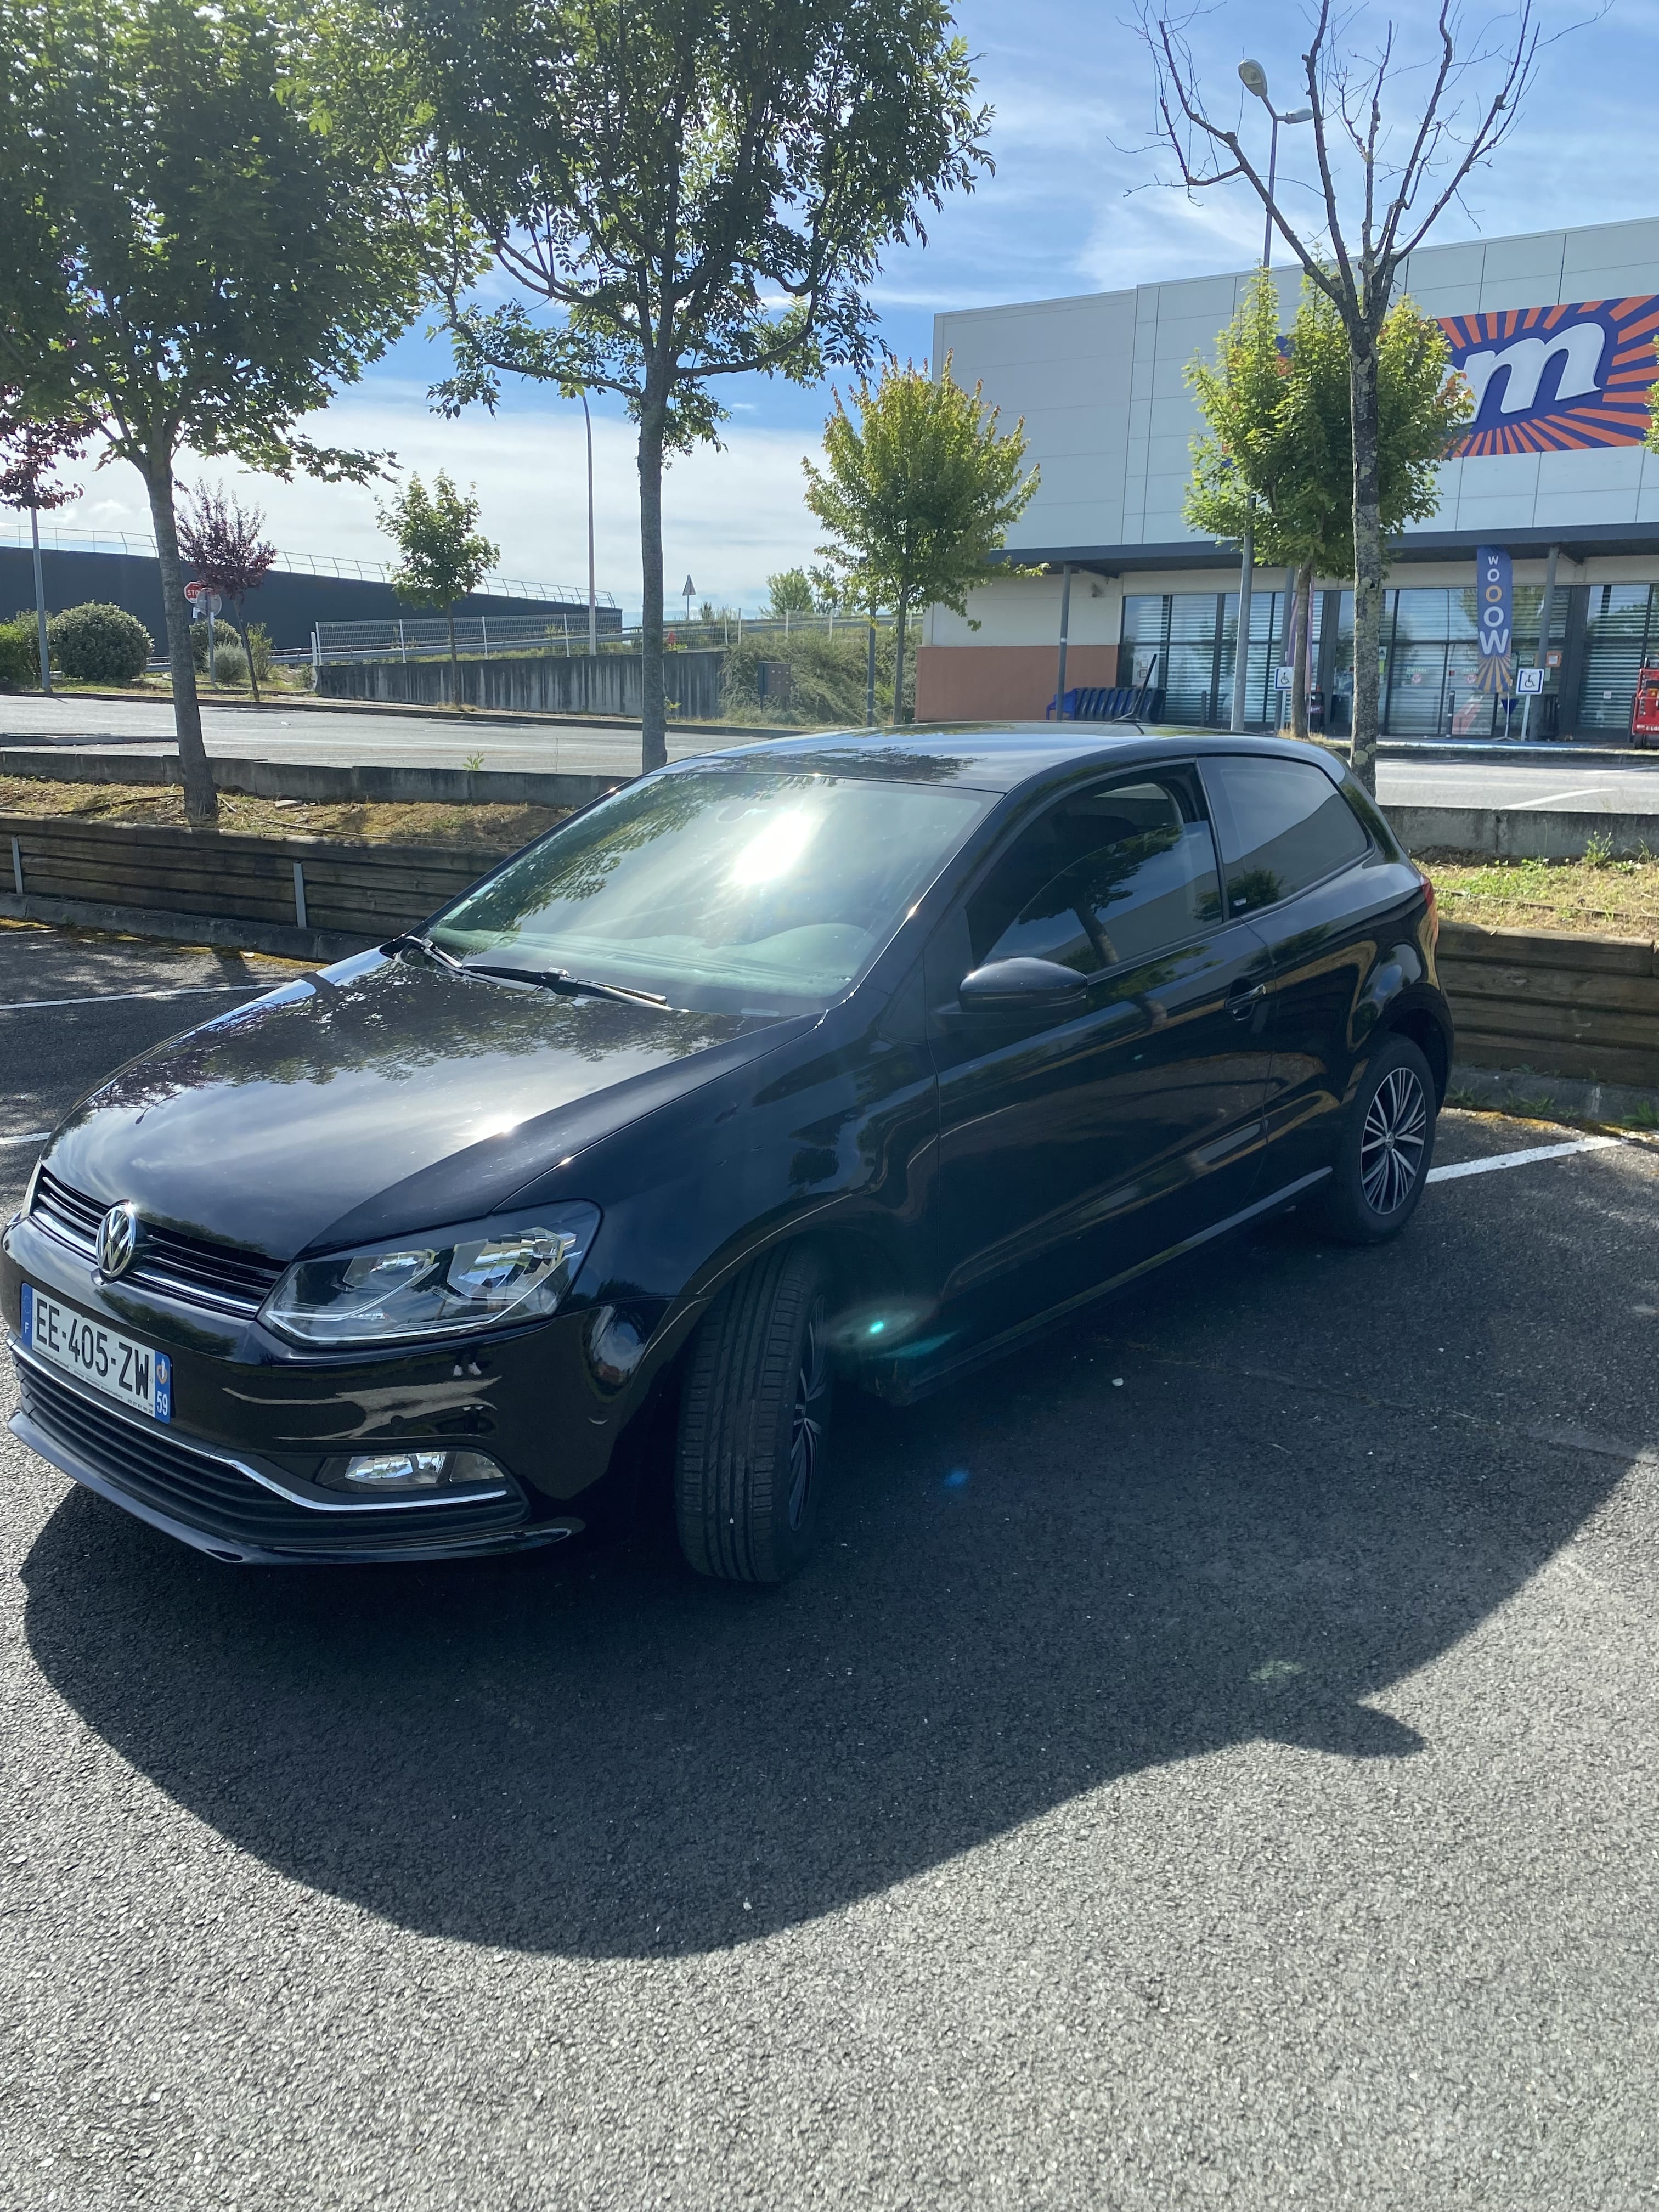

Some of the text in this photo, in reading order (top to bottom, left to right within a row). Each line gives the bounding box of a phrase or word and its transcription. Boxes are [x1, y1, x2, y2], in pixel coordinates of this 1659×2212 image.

[1436, 322, 1606, 424] m
[1479, 555, 1509, 655] WOOOW
[25, 1322, 29, 1334] F
[37, 1297, 149, 1400] EE-405-ZW
[157, 1391, 168, 1416] 59
